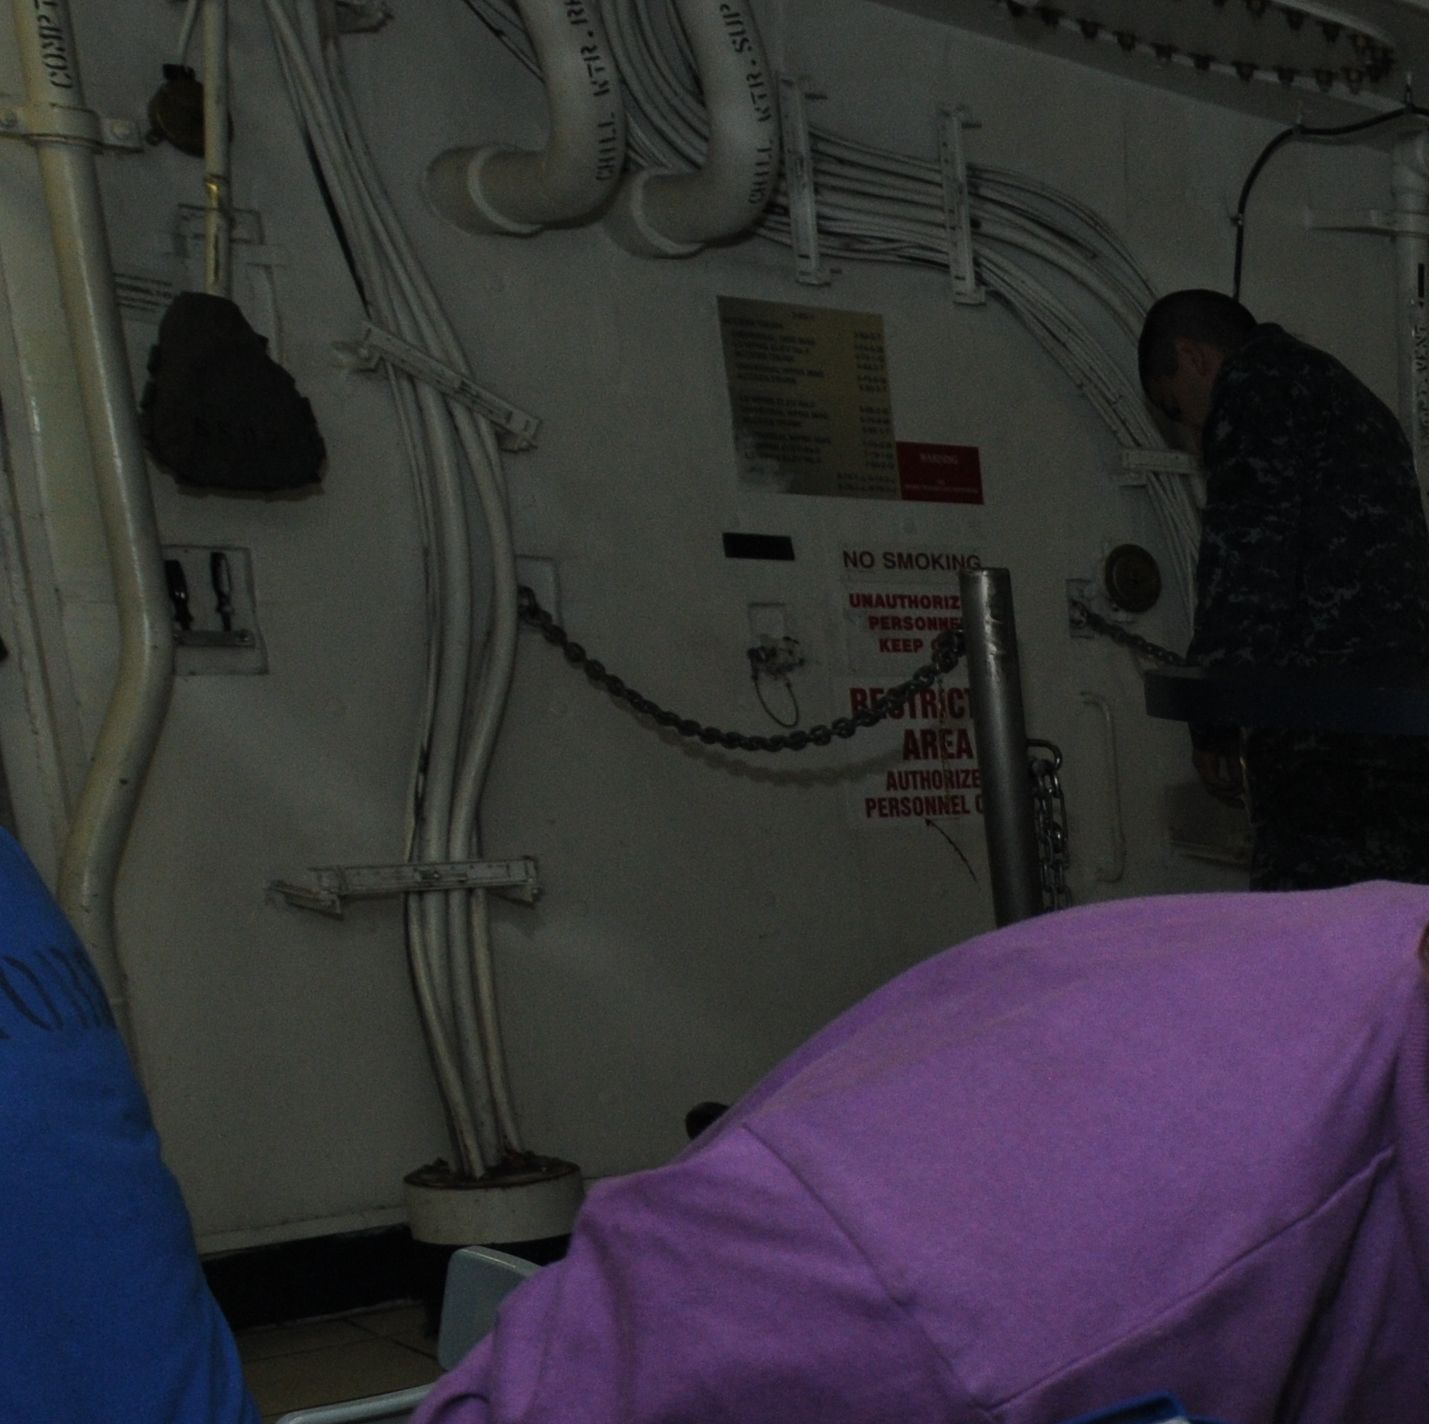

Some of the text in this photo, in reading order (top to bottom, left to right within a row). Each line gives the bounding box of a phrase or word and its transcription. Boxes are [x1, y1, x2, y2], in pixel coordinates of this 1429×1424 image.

[595, 112, 617, 181] CHILL
[747, 139, 774, 204] CHILL
[842, 550, 983, 572] NO SMOKING
[849, 592, 961, 610] UNAUTHORIZ
[868, 615, 963, 632] PERSONNE
[878, 638, 924, 653] KEEP
[902, 728, 974, 760] AREA
[886, 768, 983, 791] AUTHORIZE
[864, 796, 970, 819] PERSONNEL
